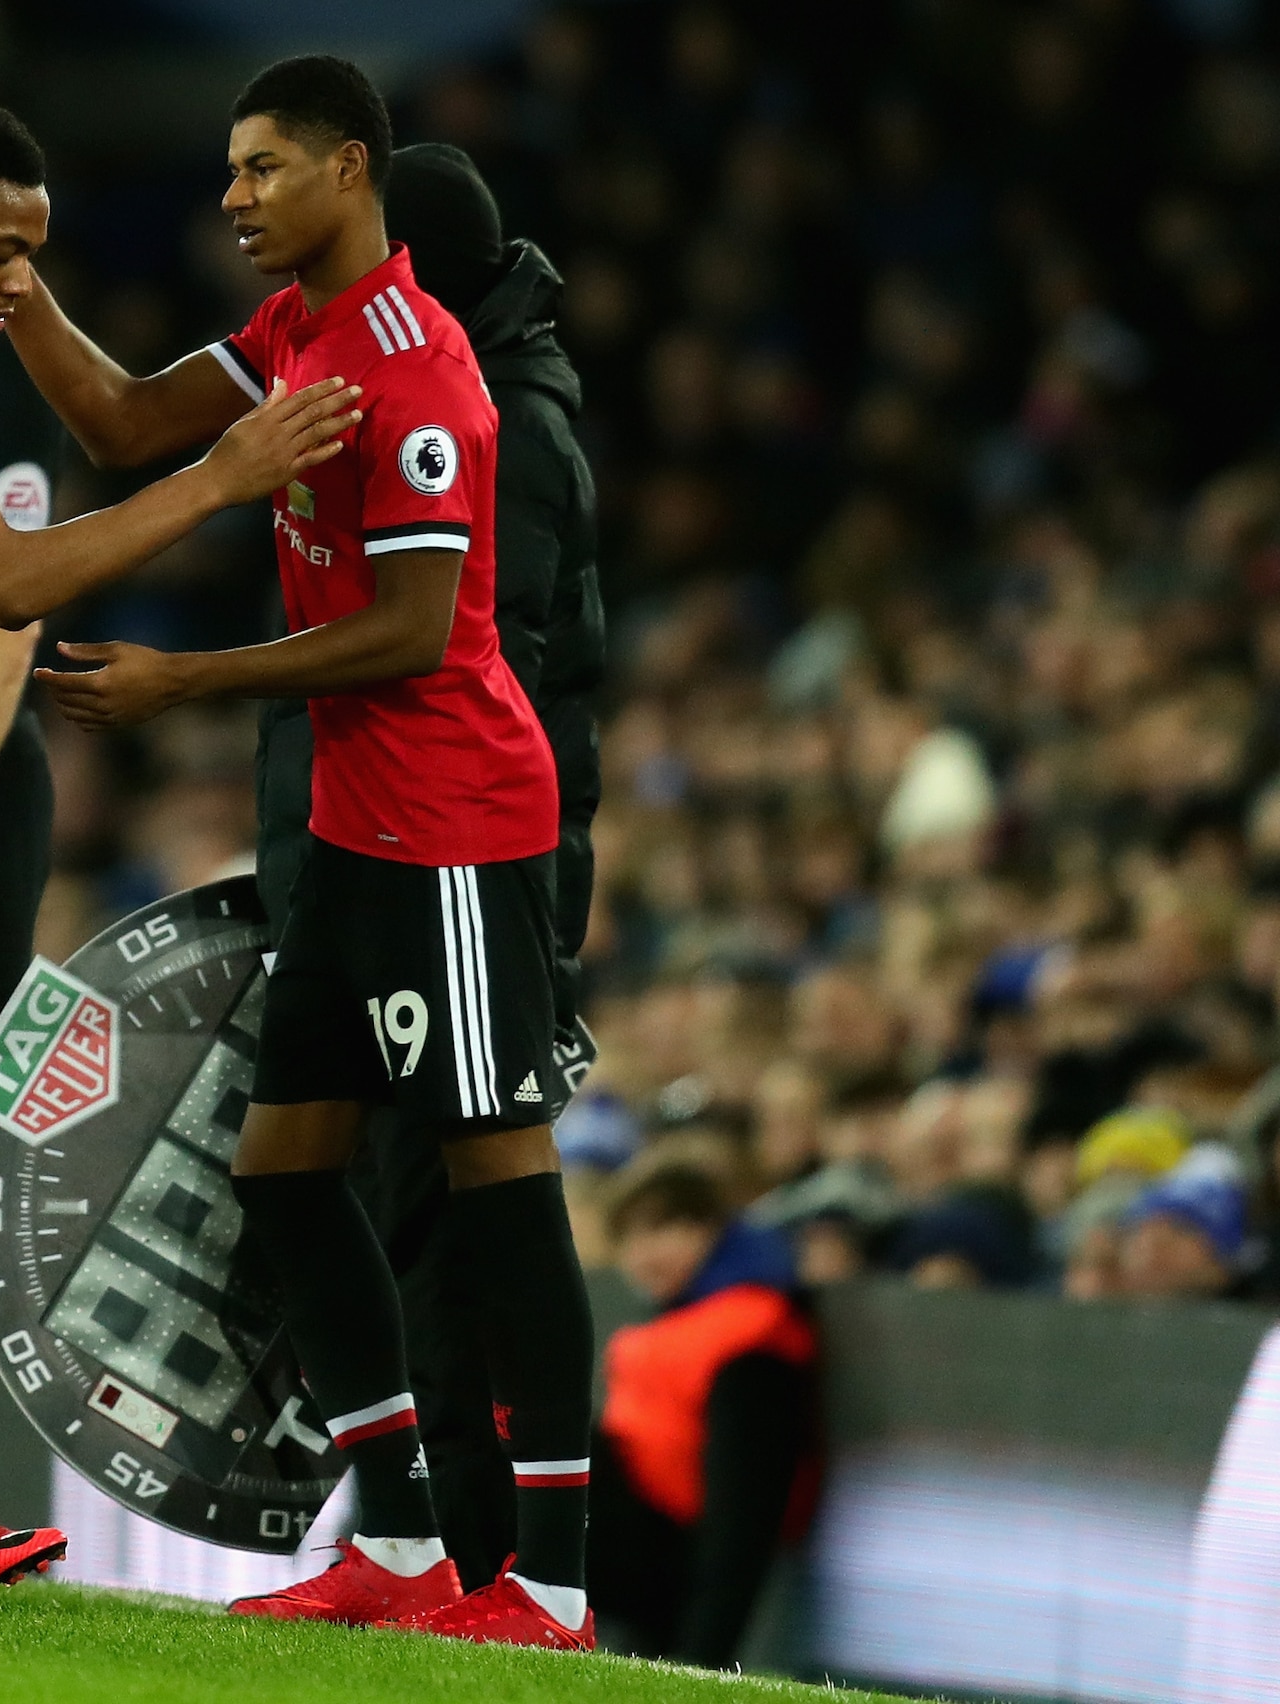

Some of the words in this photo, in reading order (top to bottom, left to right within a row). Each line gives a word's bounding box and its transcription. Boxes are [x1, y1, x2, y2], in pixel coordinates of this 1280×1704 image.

[116, 913, 178, 963] 05
[366, 989, 429, 1082] 19
[17, 1003, 107, 1128] HEUER
[513, 1090, 543, 1103] adidas
[1, 1329, 53, 1394] 50
[103, 1451, 169, 1499] 45
